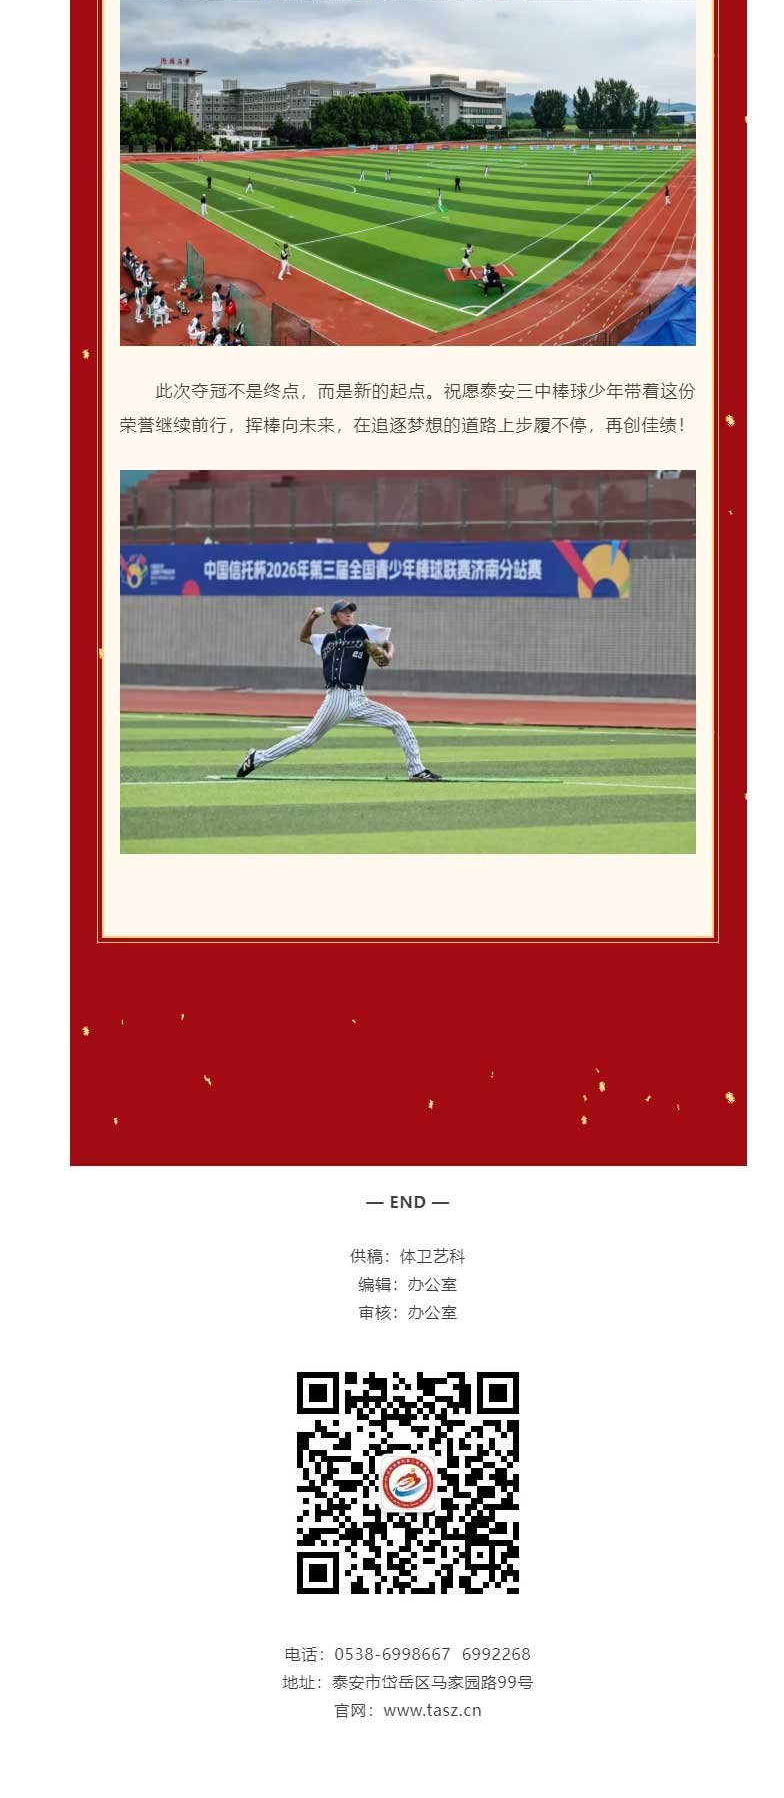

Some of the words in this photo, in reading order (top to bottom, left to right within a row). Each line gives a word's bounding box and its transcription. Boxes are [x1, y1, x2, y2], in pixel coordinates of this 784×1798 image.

[156, 382, 695, 399] 此次夺冠不是终点，而是新的起点。祝愿泰安三中棒球少年带着这份
[120, 417, 683, 433] 荣誉继续前行，挥棒向未来，在追逐梦想的道路上步履不停，再创佳绩！
[391, 1196, 426, 1208] END
[350, 1248, 465, 1264] 供稿：体卫艺科
[358, 1277, 457, 1292] 编辑：办公室
[359, 1305, 457, 1320] 审核：办公室
[463, 1648, 530, 1660] 6992268
[282, 1674, 533, 1690] 地址：泰安市岱岳区马家园路99号
